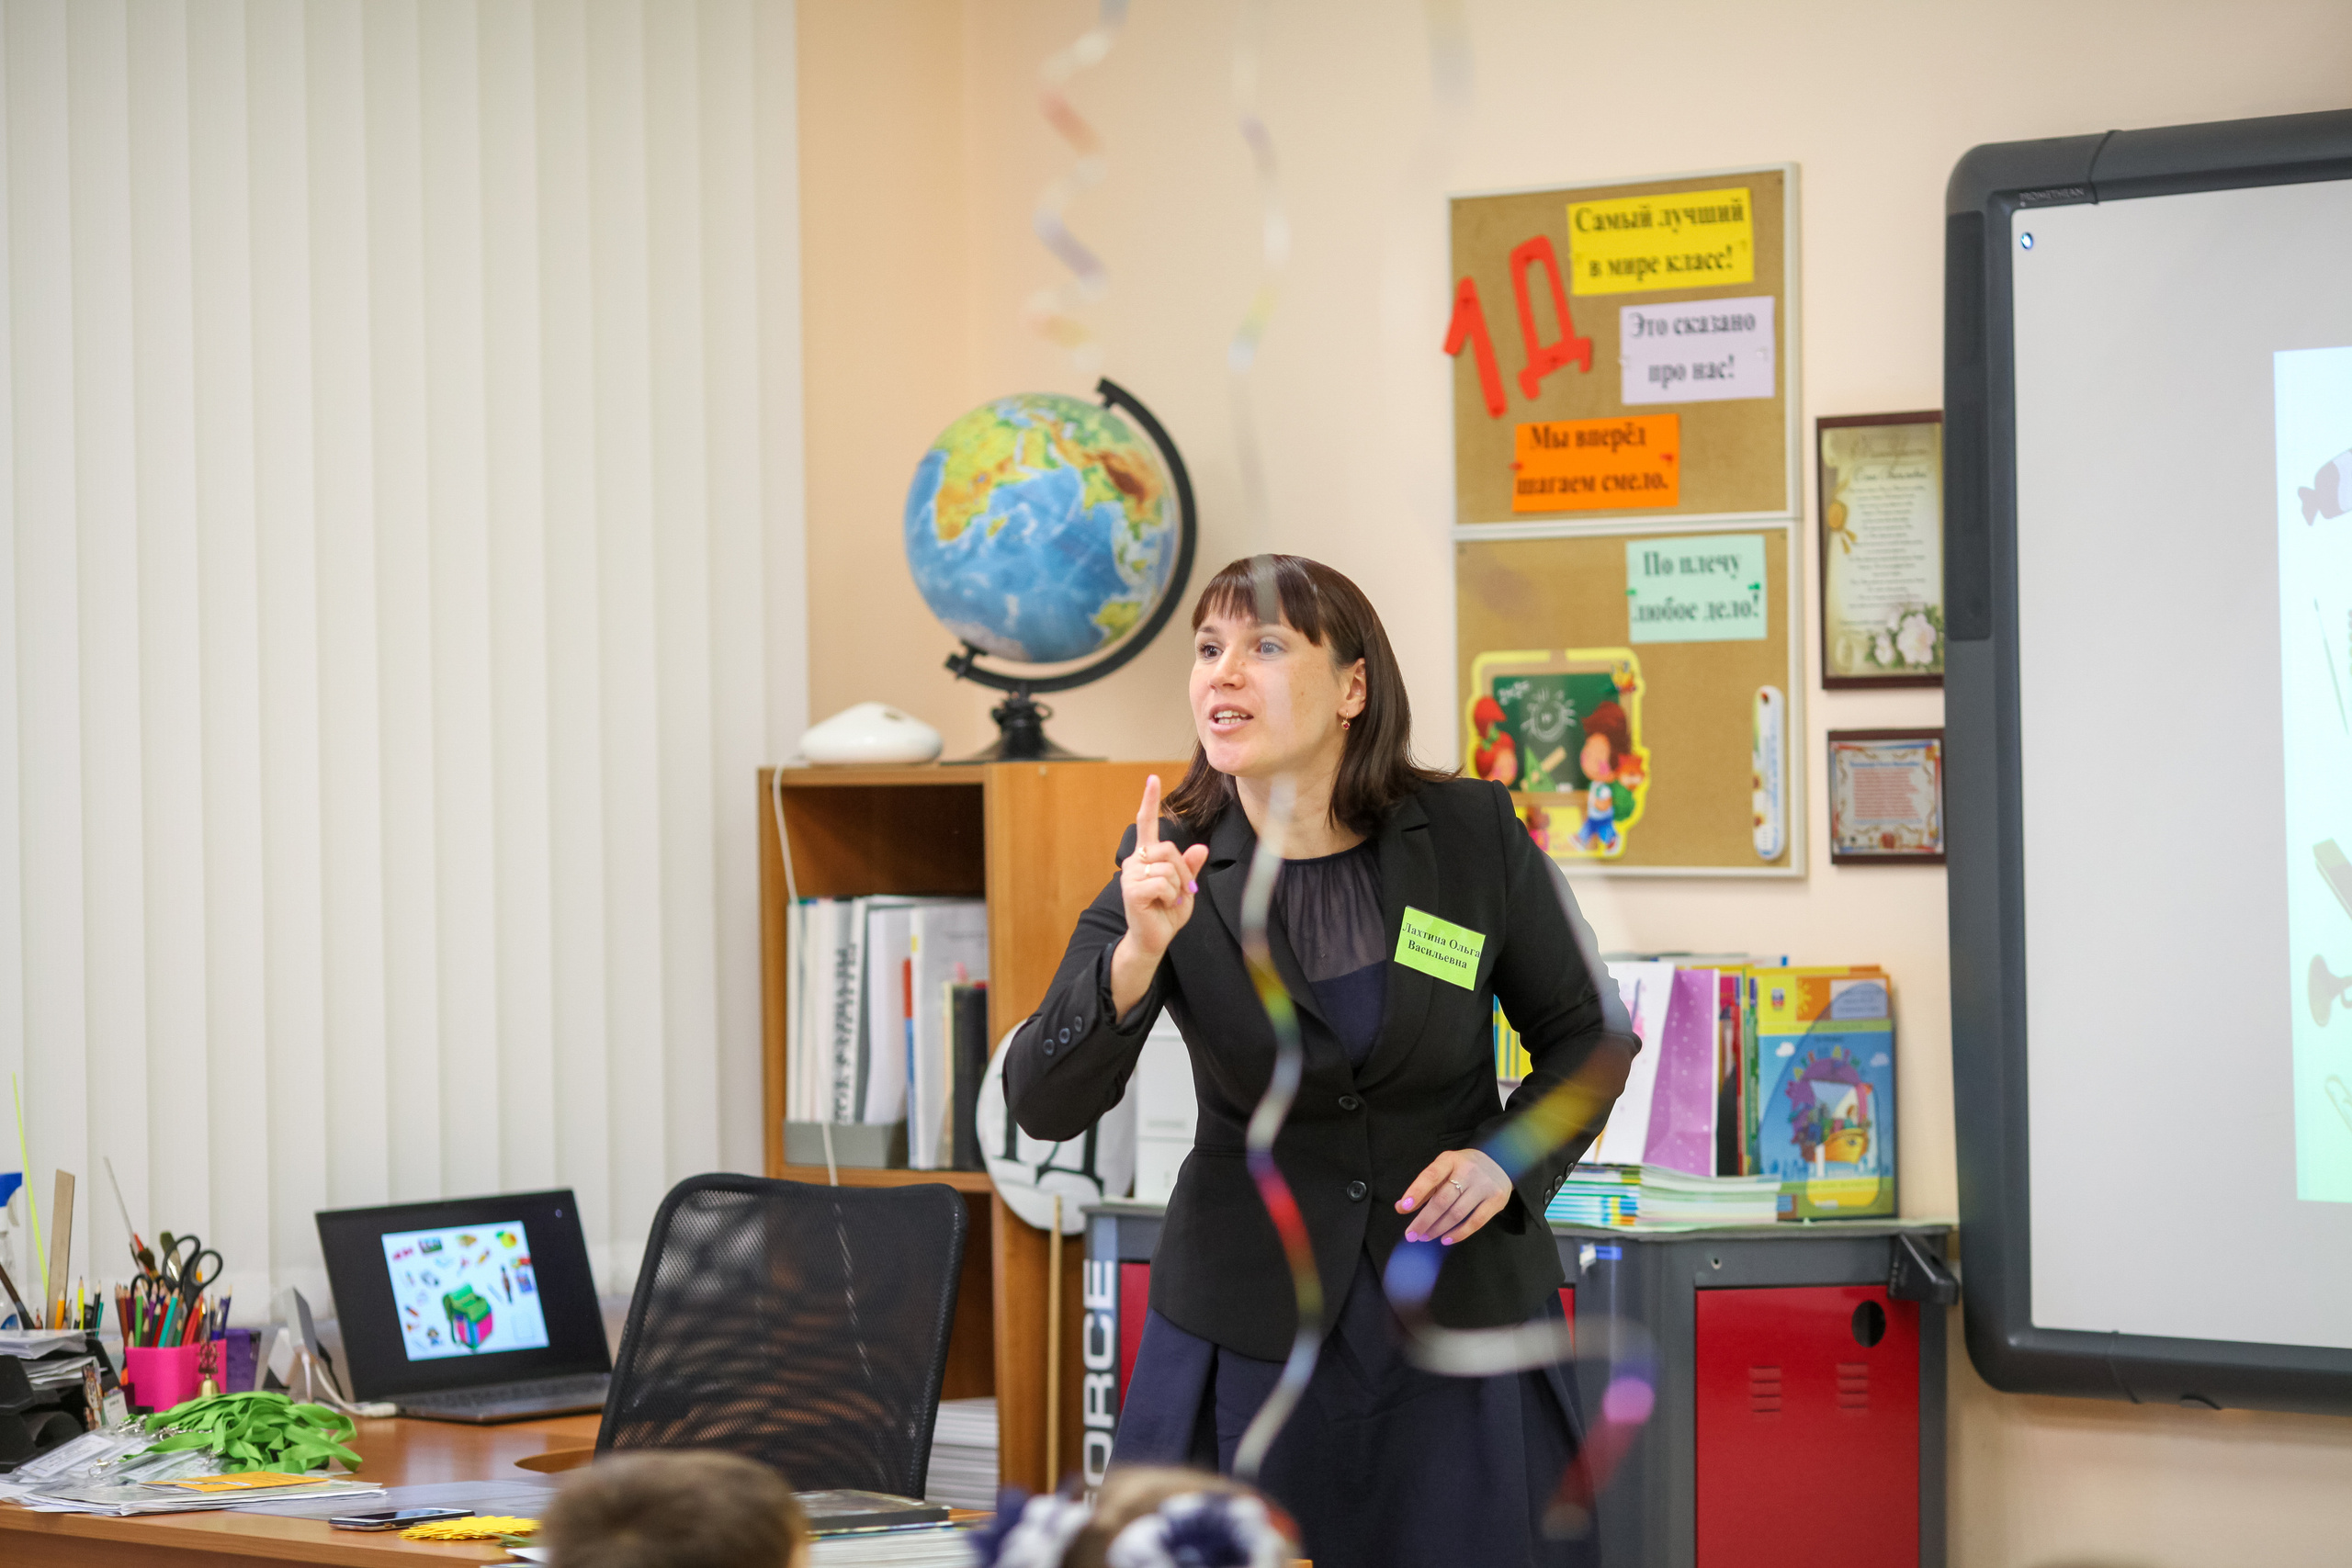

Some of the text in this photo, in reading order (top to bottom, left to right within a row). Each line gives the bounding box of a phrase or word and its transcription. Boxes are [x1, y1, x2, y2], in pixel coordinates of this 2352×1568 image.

[1575, 198, 1745, 235] Самый лучший
[1589, 244, 1734, 283] в мире класс!
[1443, 234, 1592, 419] 1Д
[1629, 311, 1757, 339] Это сказано
[1647, 355, 1736, 390] про нас!
[1529, 423, 1646, 453] Мы вперёд
[1516, 468, 1669, 496] шагаем смело.
[1644, 551, 1742, 580] По плечу
[1632, 592, 1760, 623] любое дело!
[1402, 922, 1481, 958] Лахтина Ольга
[1408, 939, 1467, 969] Васильевна
